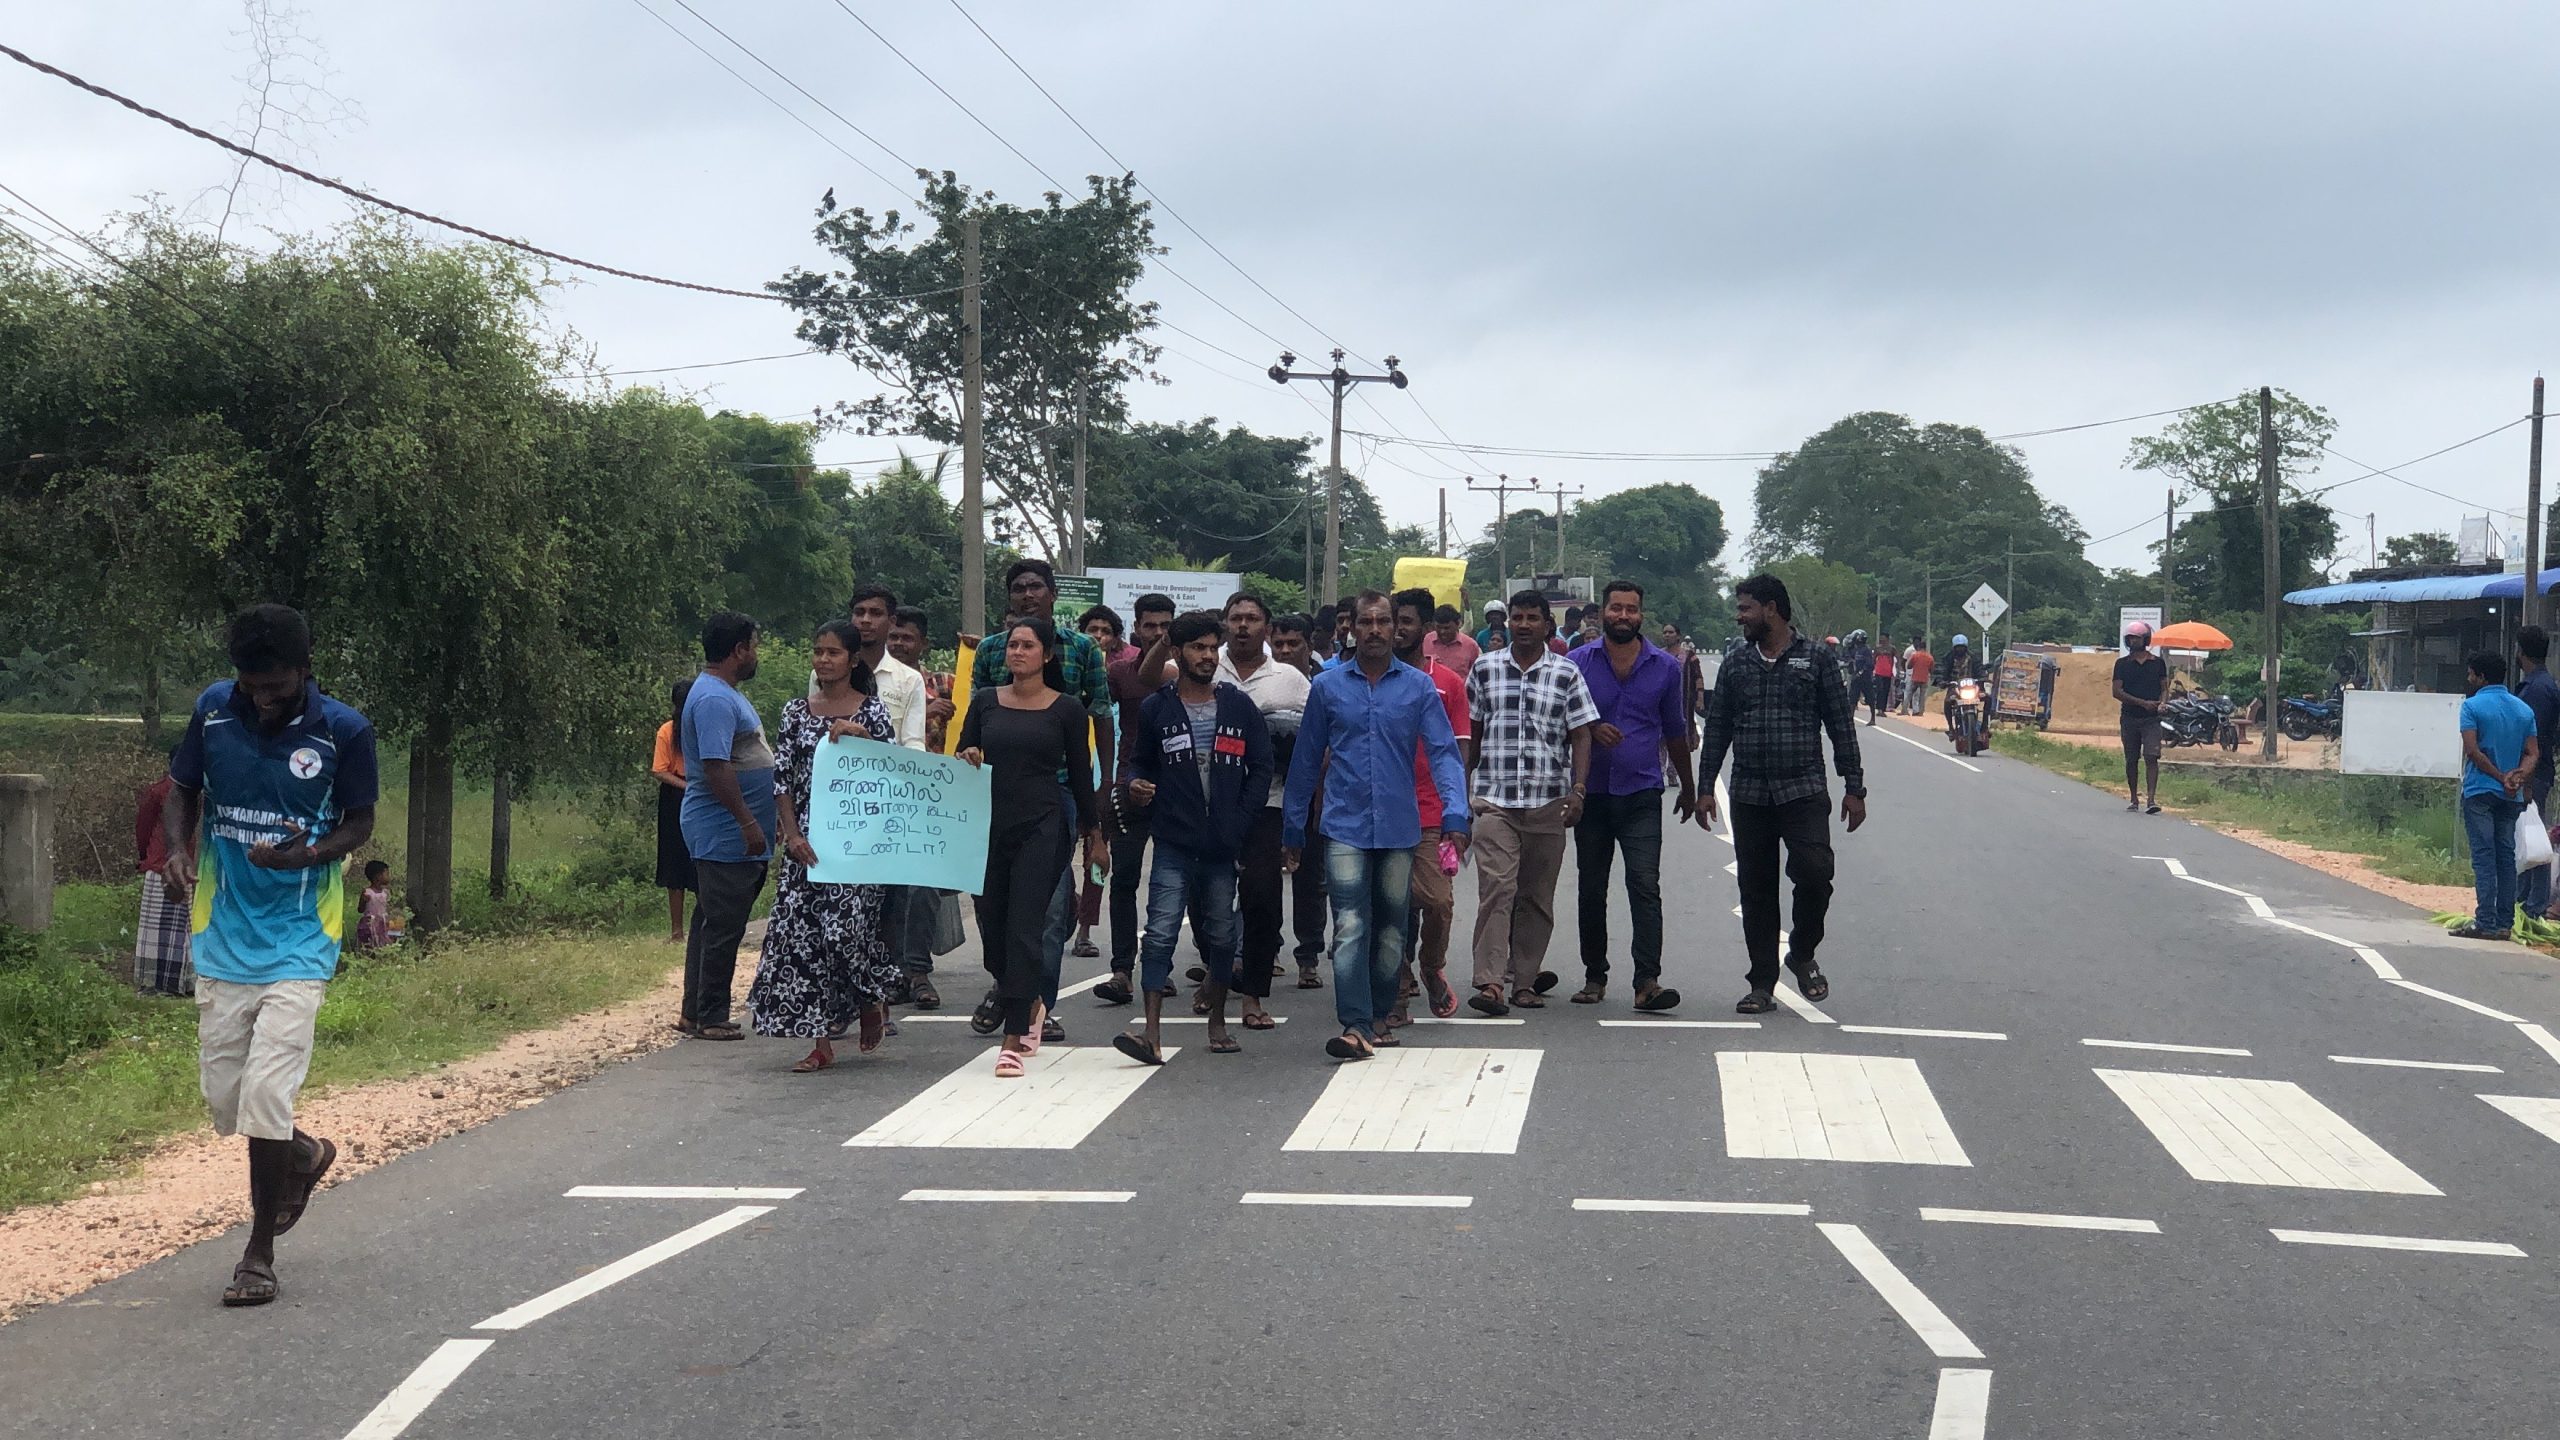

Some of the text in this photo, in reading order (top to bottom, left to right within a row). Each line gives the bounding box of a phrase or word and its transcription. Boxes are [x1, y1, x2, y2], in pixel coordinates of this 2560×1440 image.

[1117, 582, 1134, 590] Small
[1170, 585, 1208, 593] Development
[1128, 591, 1142, 599] Proj
[1183, 593, 1196, 601] East
[829, 777, 942, 803] காணியில்
